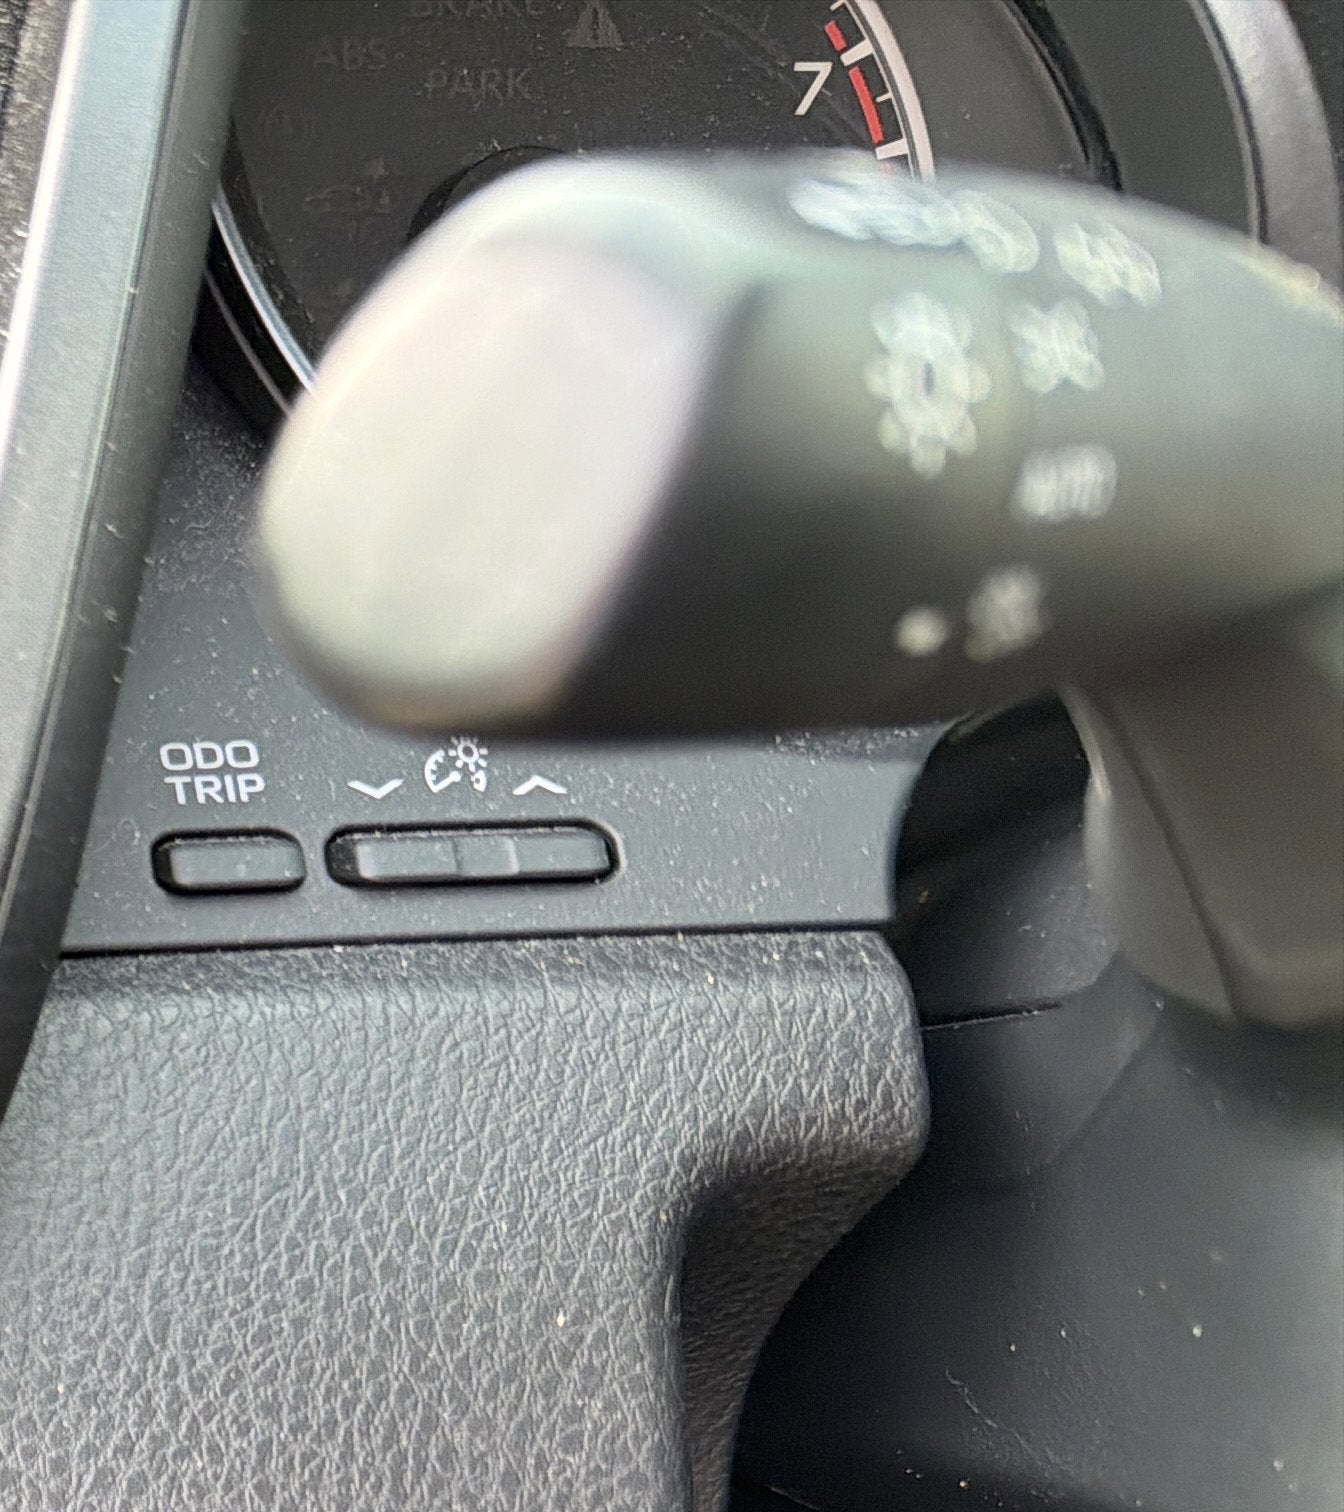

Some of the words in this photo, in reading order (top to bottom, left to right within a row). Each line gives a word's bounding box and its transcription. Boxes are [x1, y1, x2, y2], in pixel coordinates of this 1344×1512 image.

[312, 35, 387, 72] ABS
[426, 67, 535, 101] PARK
[793, 61, 833, 116] 7
[159, 740, 261, 771] ODO
[163, 773, 267, 805] TRIP
